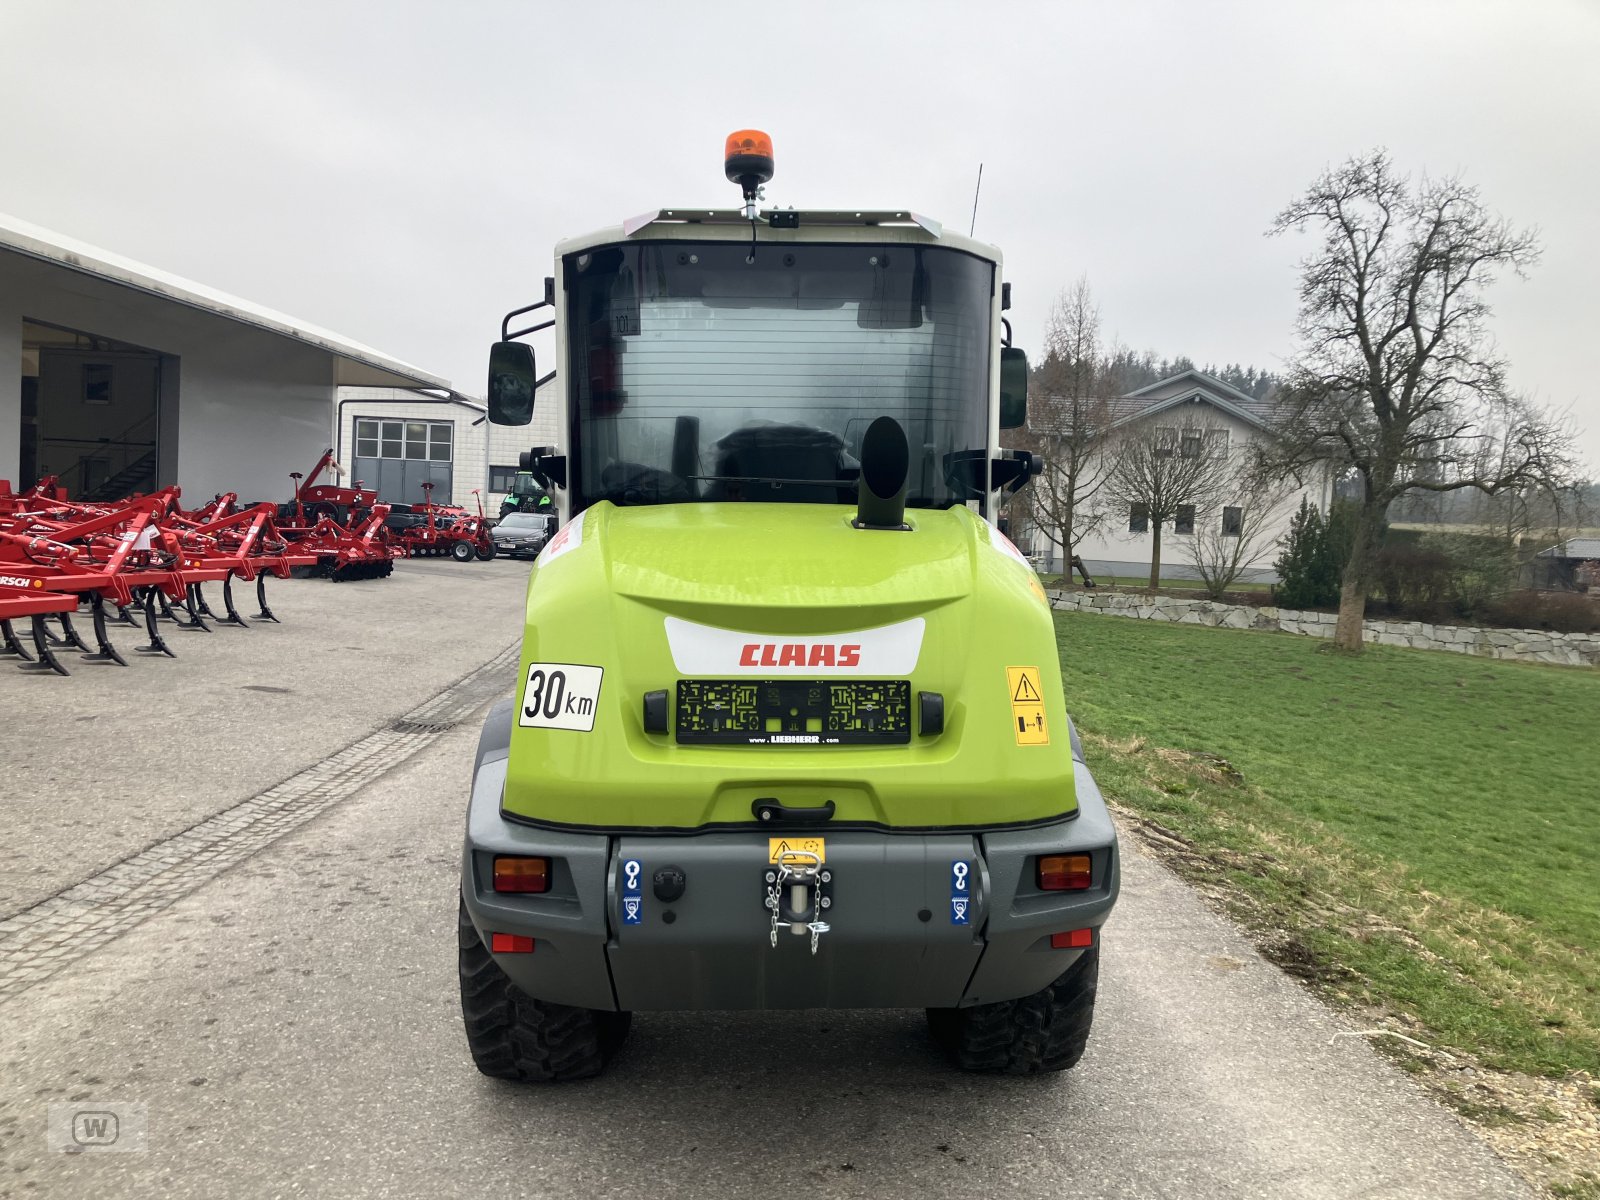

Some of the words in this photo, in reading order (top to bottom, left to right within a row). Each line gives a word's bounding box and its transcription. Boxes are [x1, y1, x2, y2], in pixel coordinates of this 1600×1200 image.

[0, 576, 30, 587] RSCH
[739, 644, 861, 667] CLAAS
[524, 669, 566, 719] 30
[565, 691, 593, 716] km
